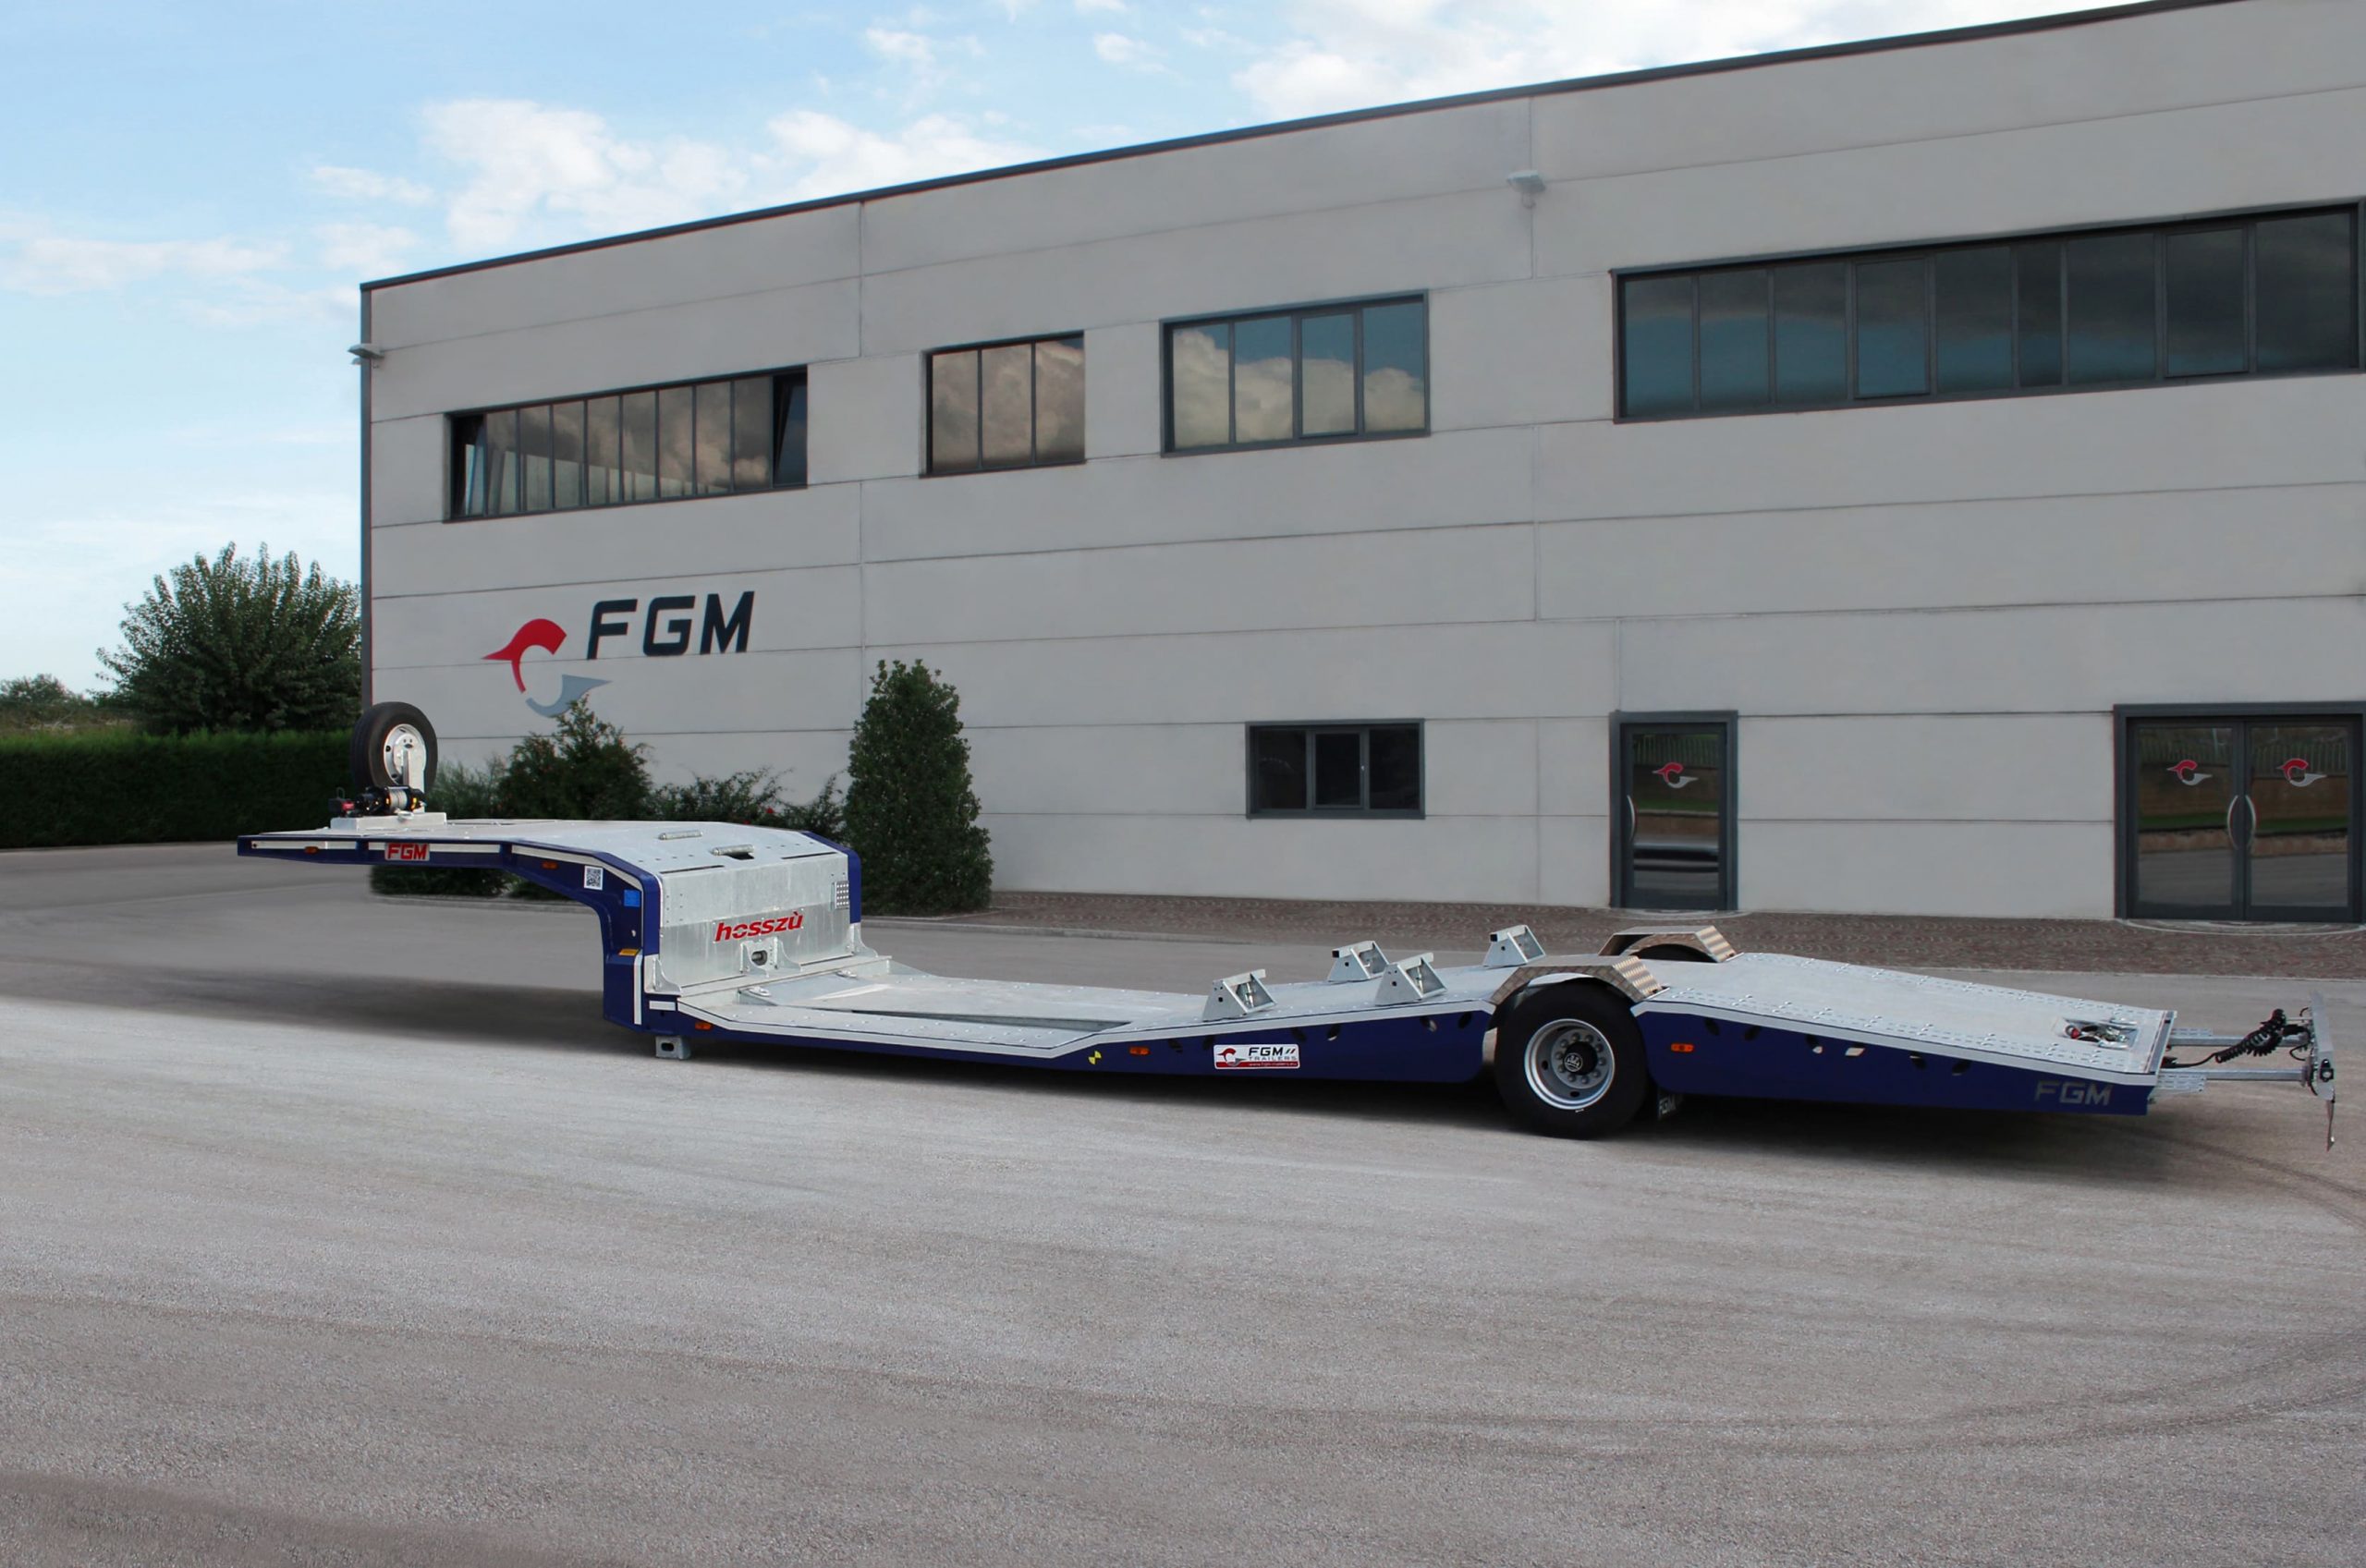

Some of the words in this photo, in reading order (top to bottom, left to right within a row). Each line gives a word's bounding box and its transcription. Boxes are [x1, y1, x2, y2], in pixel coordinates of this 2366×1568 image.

[586, 590, 755, 660] FGM
[387, 843, 428, 860] FGM
[1249, 1047, 1284, 1056] FGM
[2034, 1080, 2114, 1106] FGM
